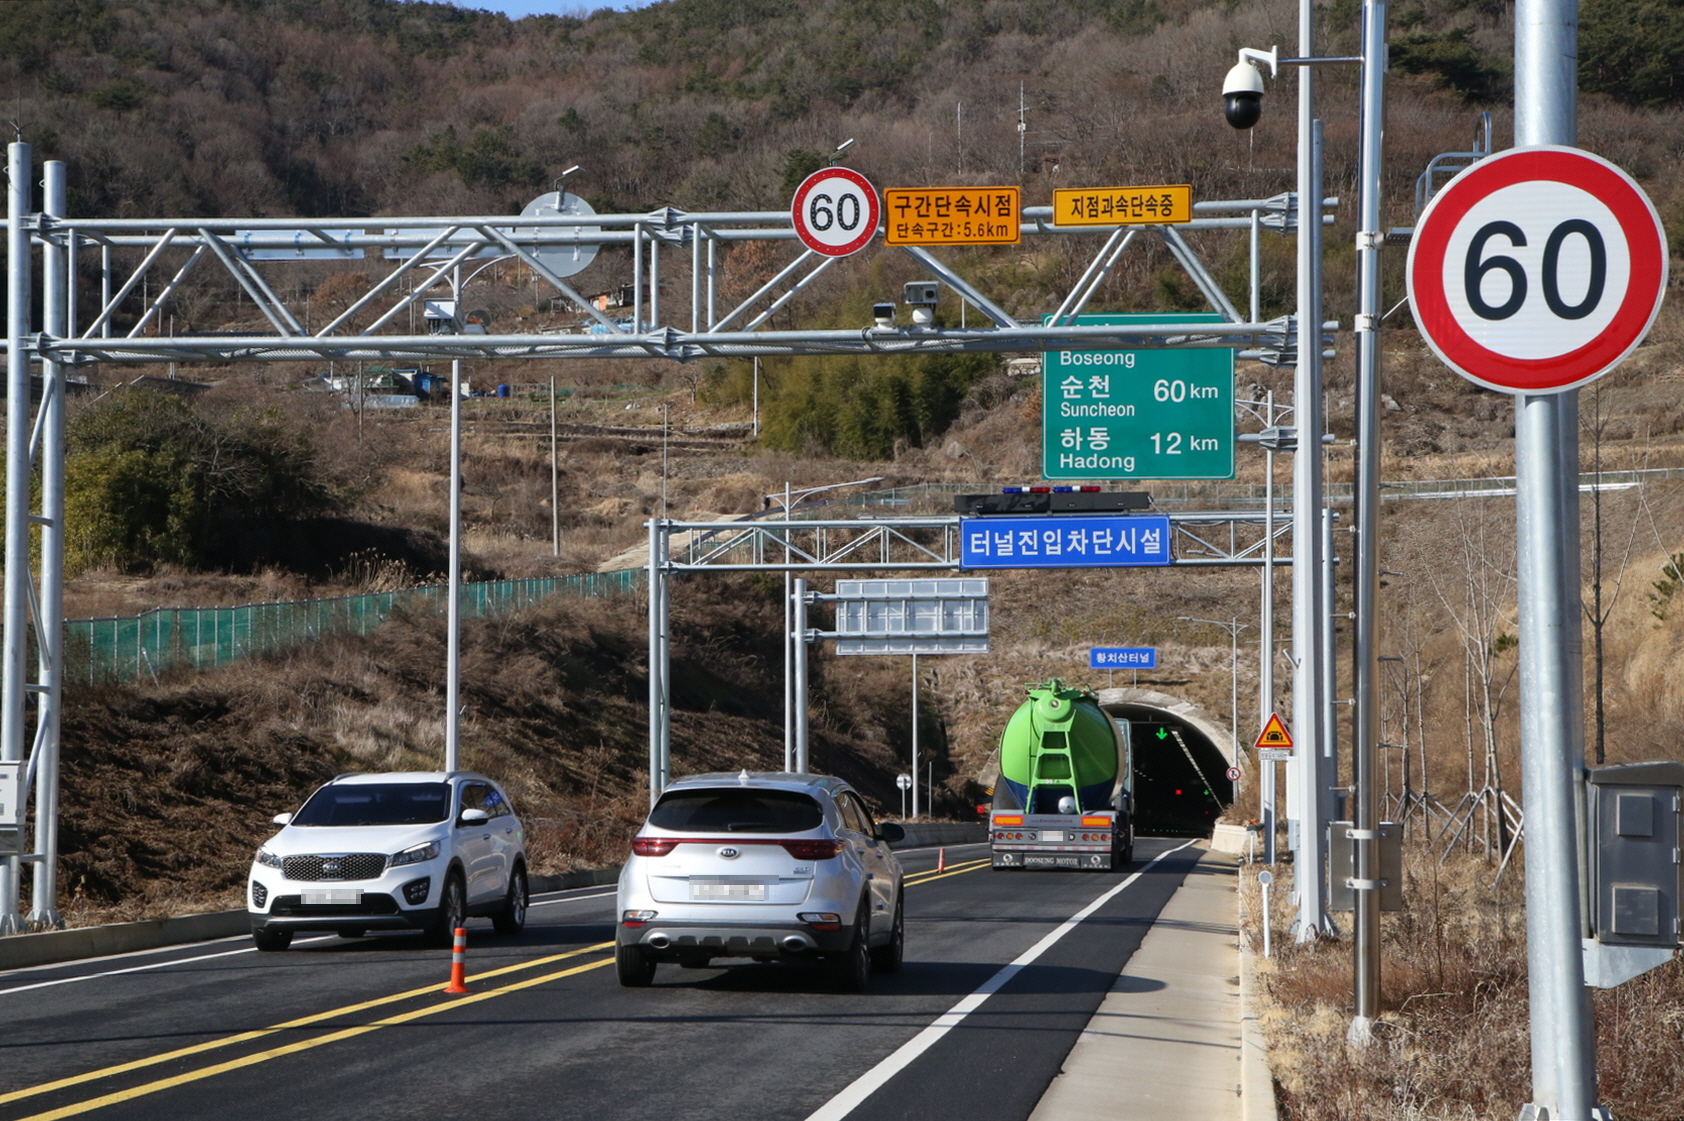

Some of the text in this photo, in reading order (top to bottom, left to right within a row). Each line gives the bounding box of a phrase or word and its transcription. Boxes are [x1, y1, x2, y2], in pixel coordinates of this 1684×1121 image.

[810, 193, 859, 231] 60
[894, 195, 1011, 218] 구간단속시점
[1071, 194, 1174, 218] 지점과속단속중
[1464, 218, 1607, 321] 60
[1060, 350, 1135, 368] Boseong
[1060, 375, 1219, 402] 순천 60 km
[1060, 401, 1135, 417] Suncheon
[1060, 426, 1219, 454] 하동 12 km
[1060, 453, 1135, 472] Hadong
[970, 527, 1161, 556] 터널진입차단시설
[1096, 652, 1149, 663] 황치산터널
[1025, 856, 1054, 865] DOOSUNG
[1056, 857, 1078, 865] MOTOR
